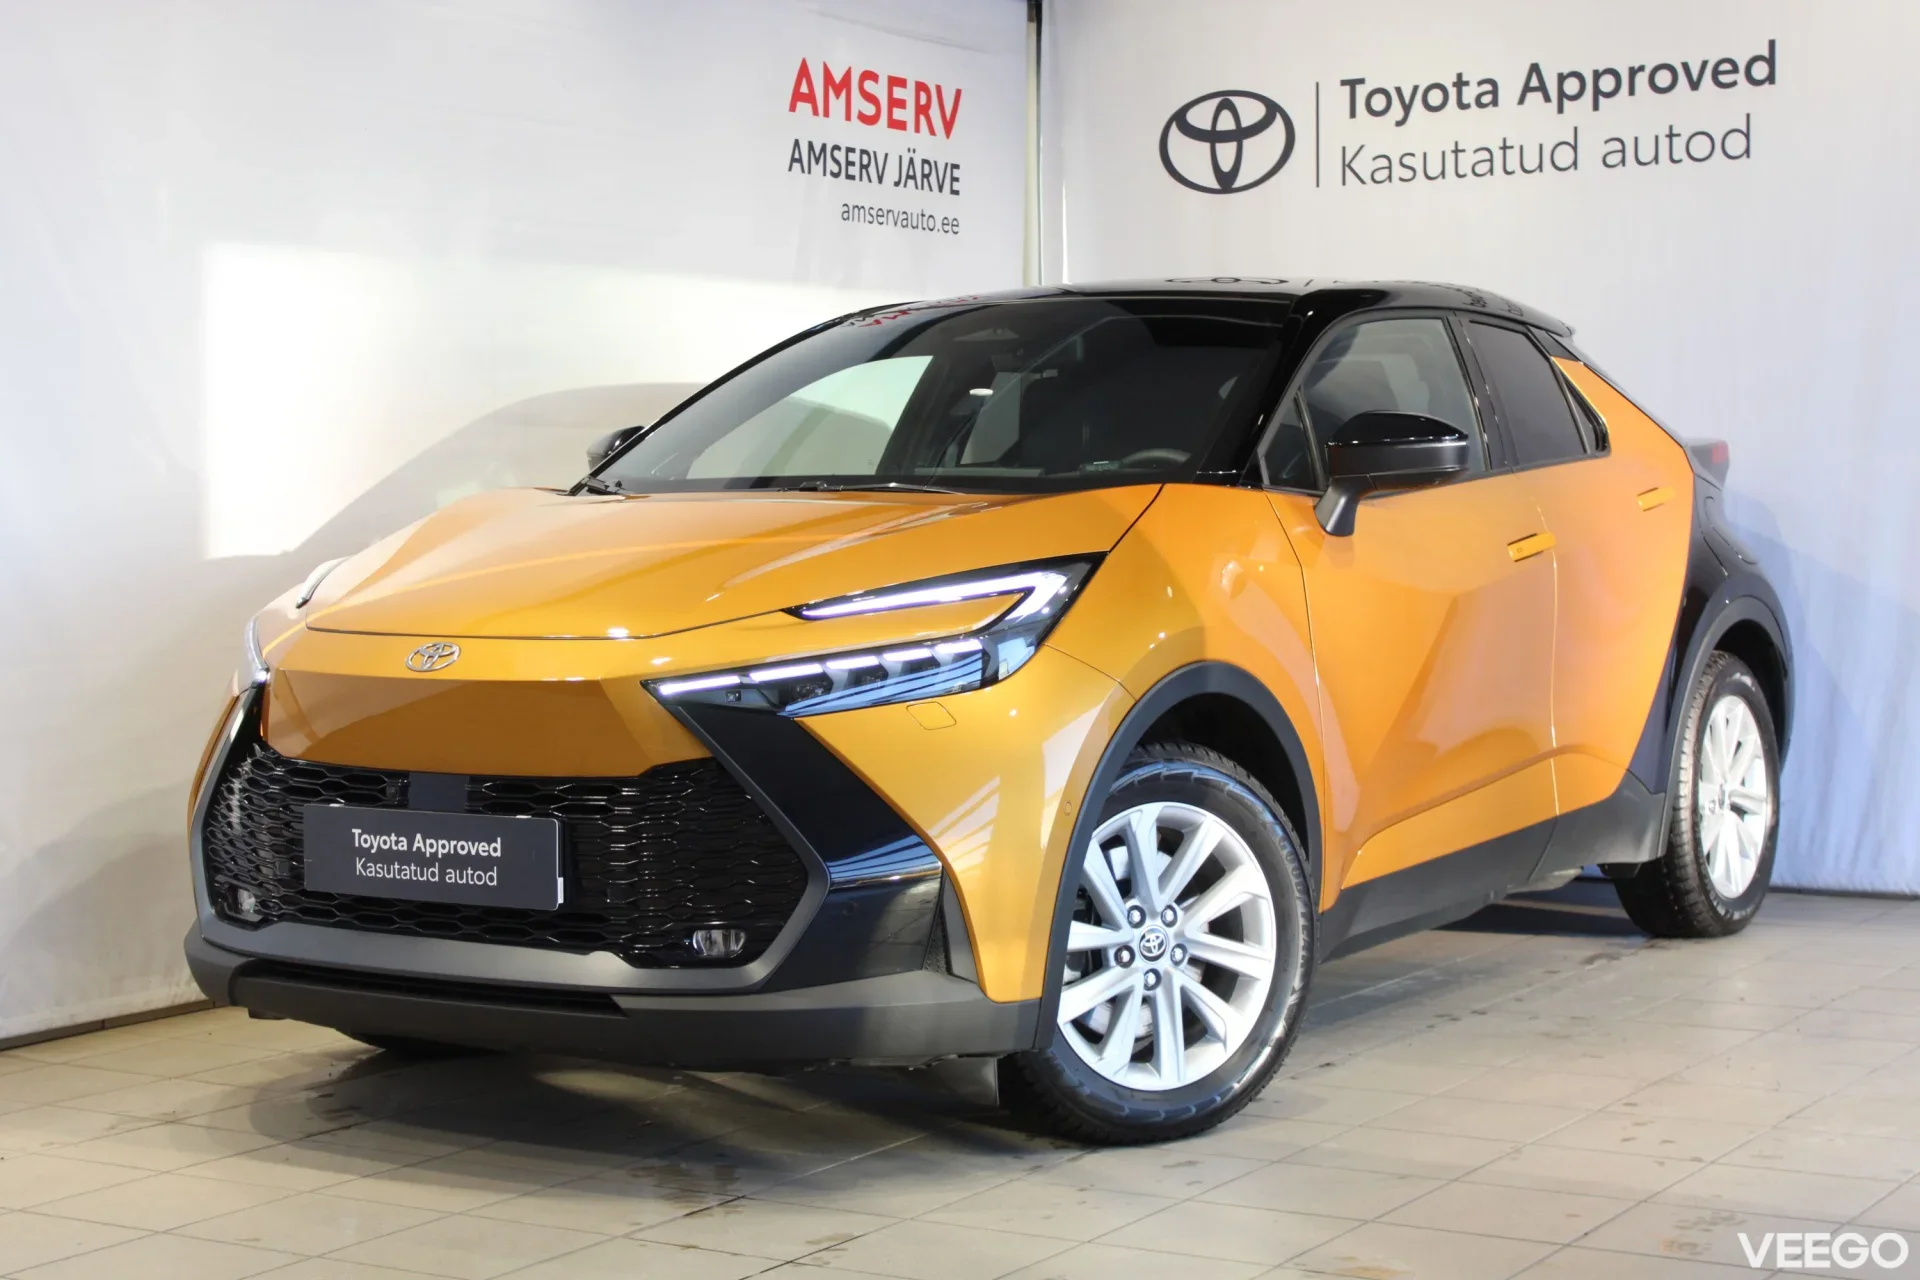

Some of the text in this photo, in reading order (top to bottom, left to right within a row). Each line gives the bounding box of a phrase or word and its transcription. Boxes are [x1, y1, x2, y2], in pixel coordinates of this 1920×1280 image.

[788, 57, 962, 140] AMSERV
[1340, 38, 1777, 127] Toyota Approved
[788, 138, 960, 196] AMSERV JÄRVE
[1341, 113, 1751, 187] Kasutatud autod
[841, 203, 960, 235] amservauto.ee
[351, 828, 502, 858] Toyota Approved
[356, 857, 497, 886] Kasutatud autod
